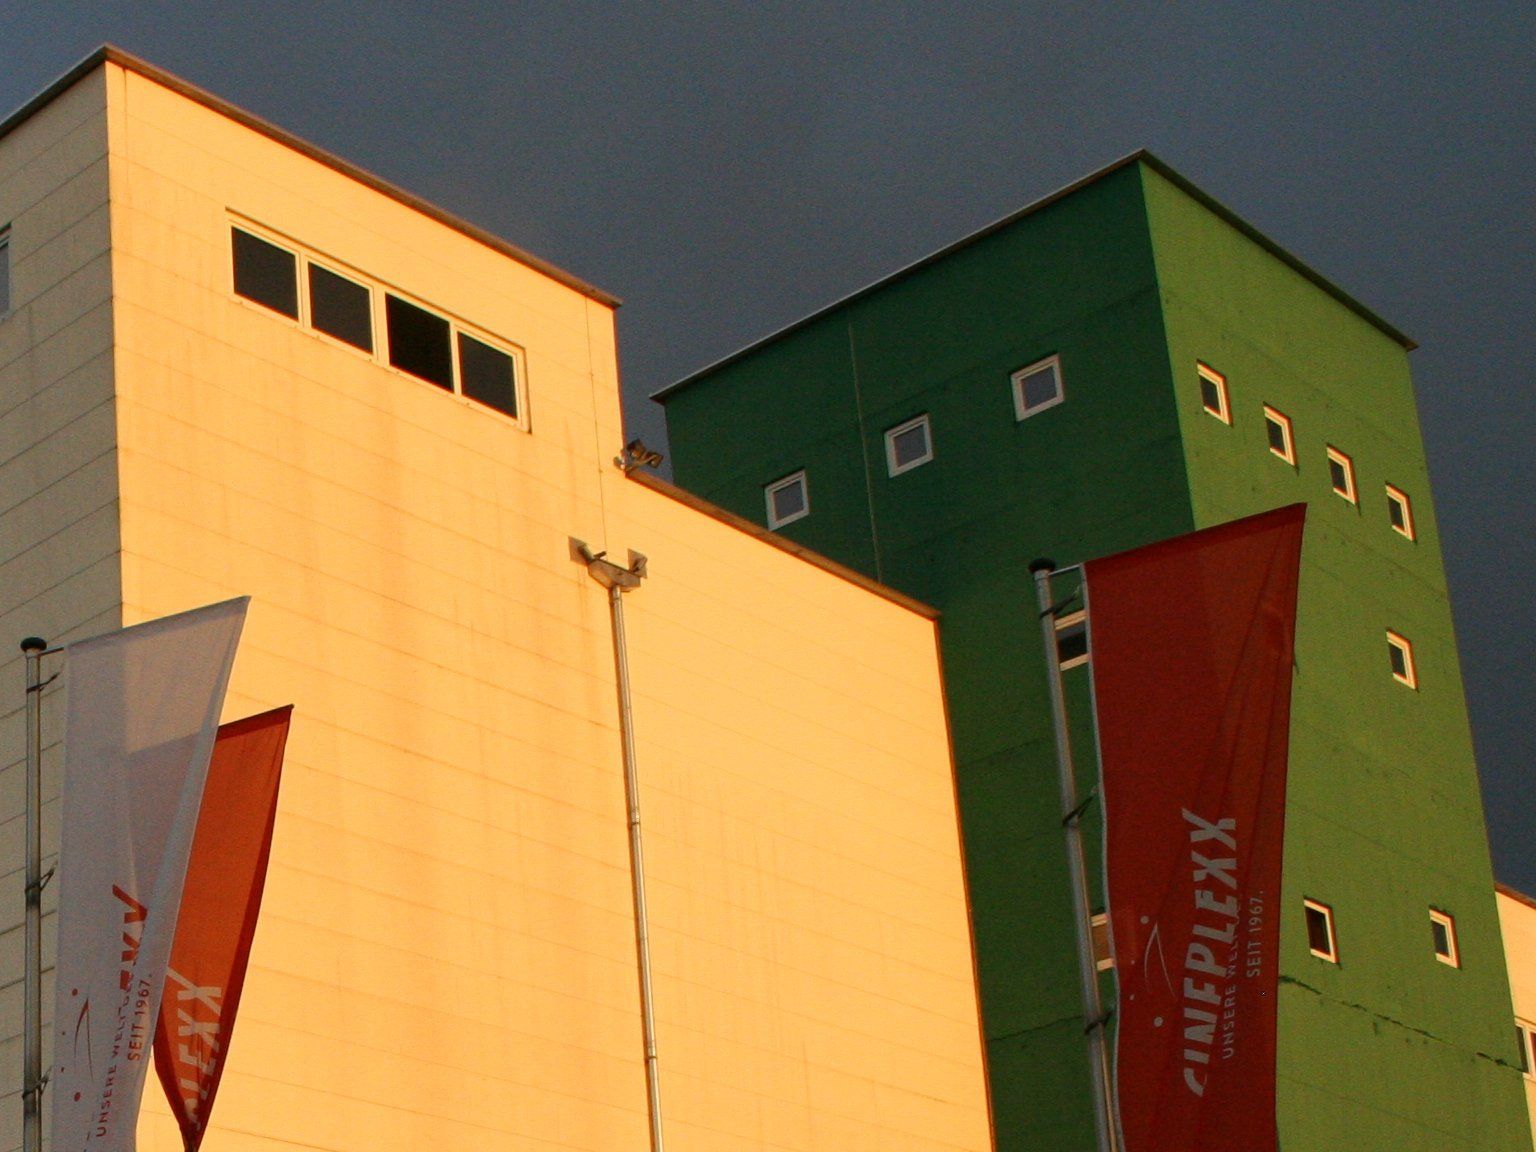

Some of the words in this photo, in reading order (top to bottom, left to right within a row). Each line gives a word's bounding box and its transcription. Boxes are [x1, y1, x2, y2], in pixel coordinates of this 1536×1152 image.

[1245, 940, 1263, 978] SEIT
[133, 972, 154, 1017] 1967.
[127, 1024, 146, 1061] SEIT
[1221, 984, 1238, 1060] UNSERE
[96, 1064, 117, 1138] UNSERE
